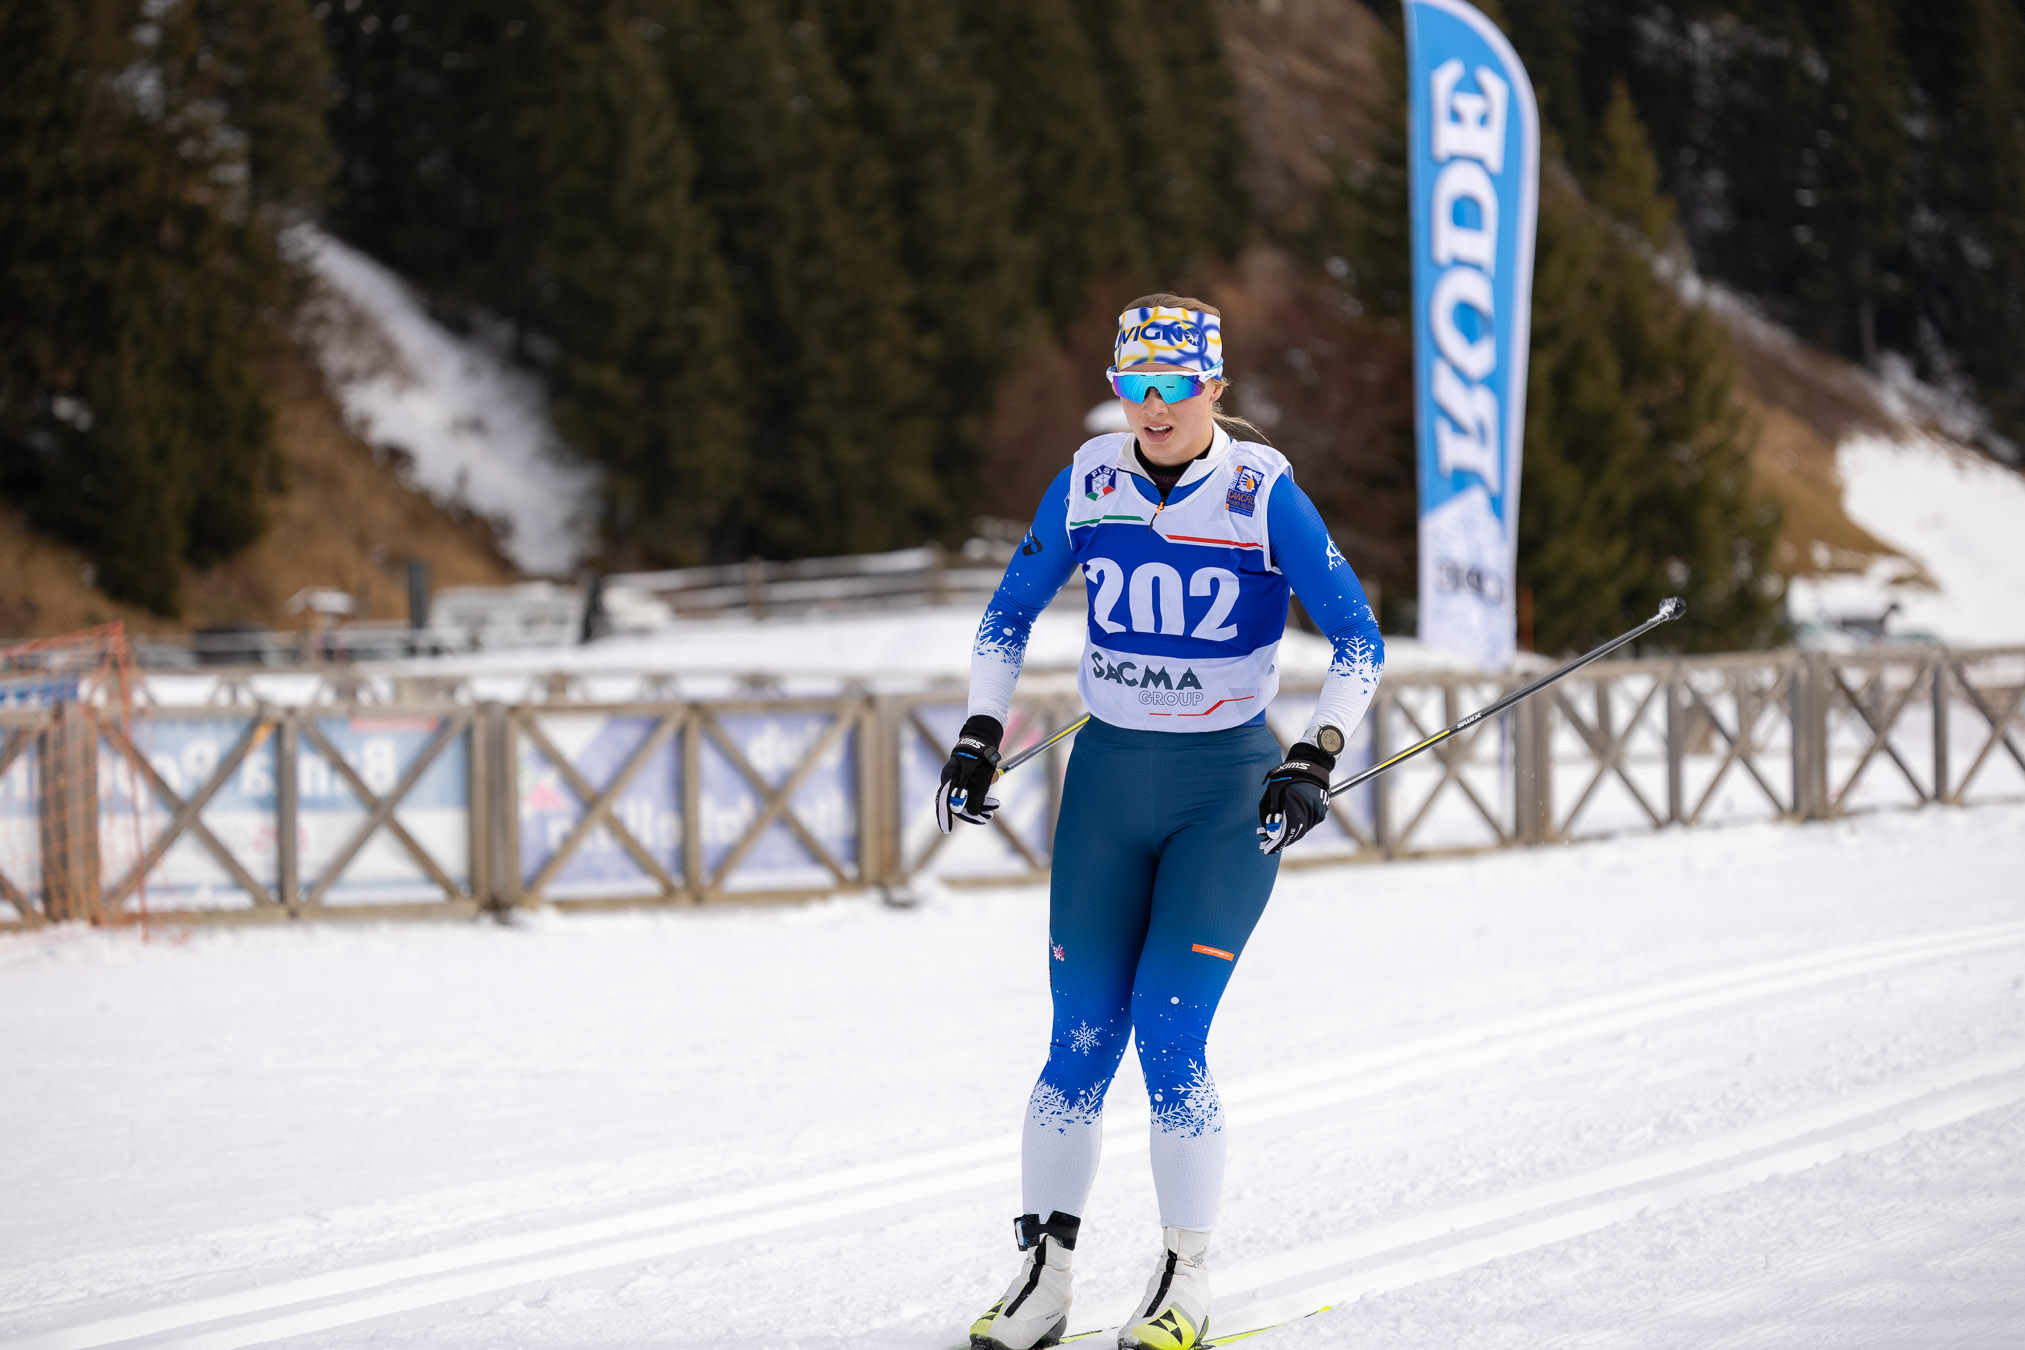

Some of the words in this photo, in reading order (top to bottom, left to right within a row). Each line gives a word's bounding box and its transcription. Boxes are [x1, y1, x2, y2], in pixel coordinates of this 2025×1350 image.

[1091, 467, 1115, 478] FISI
[1085, 557, 1240, 642] 202
[1090, 651, 1203, 690] SACMA
[1138, 690, 1204, 707] GROUP
